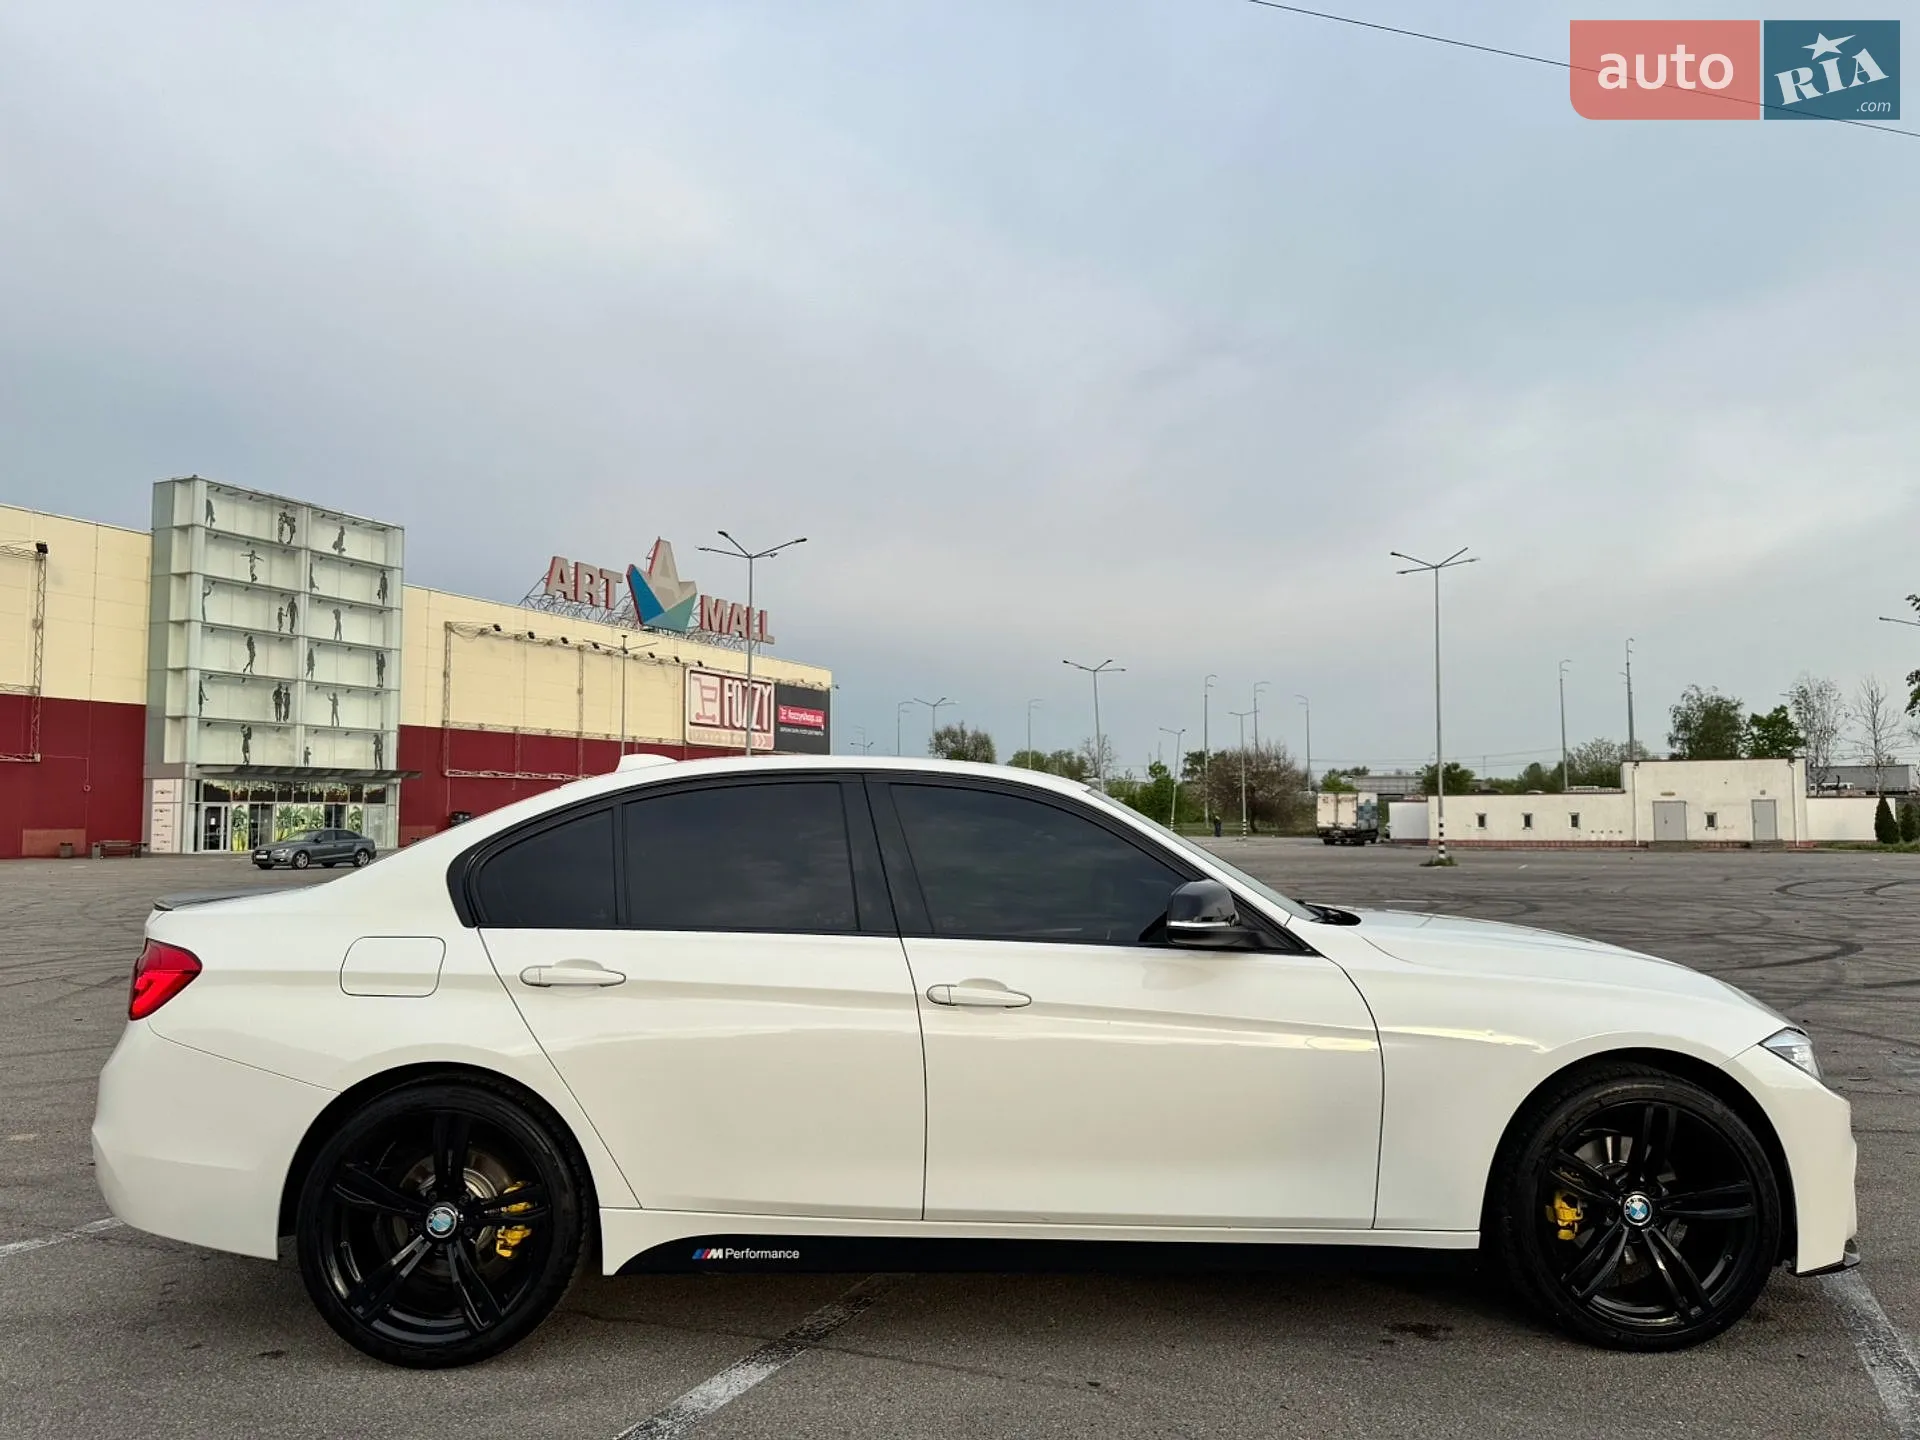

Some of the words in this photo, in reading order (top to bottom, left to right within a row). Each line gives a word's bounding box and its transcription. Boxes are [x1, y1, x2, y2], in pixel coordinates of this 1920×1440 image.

[545, 556, 624, 610] ART
[700, 594, 776, 645] MALL
[723, 678, 772, 731] FOZZY
[725, 1248, 800, 1259] Performance
